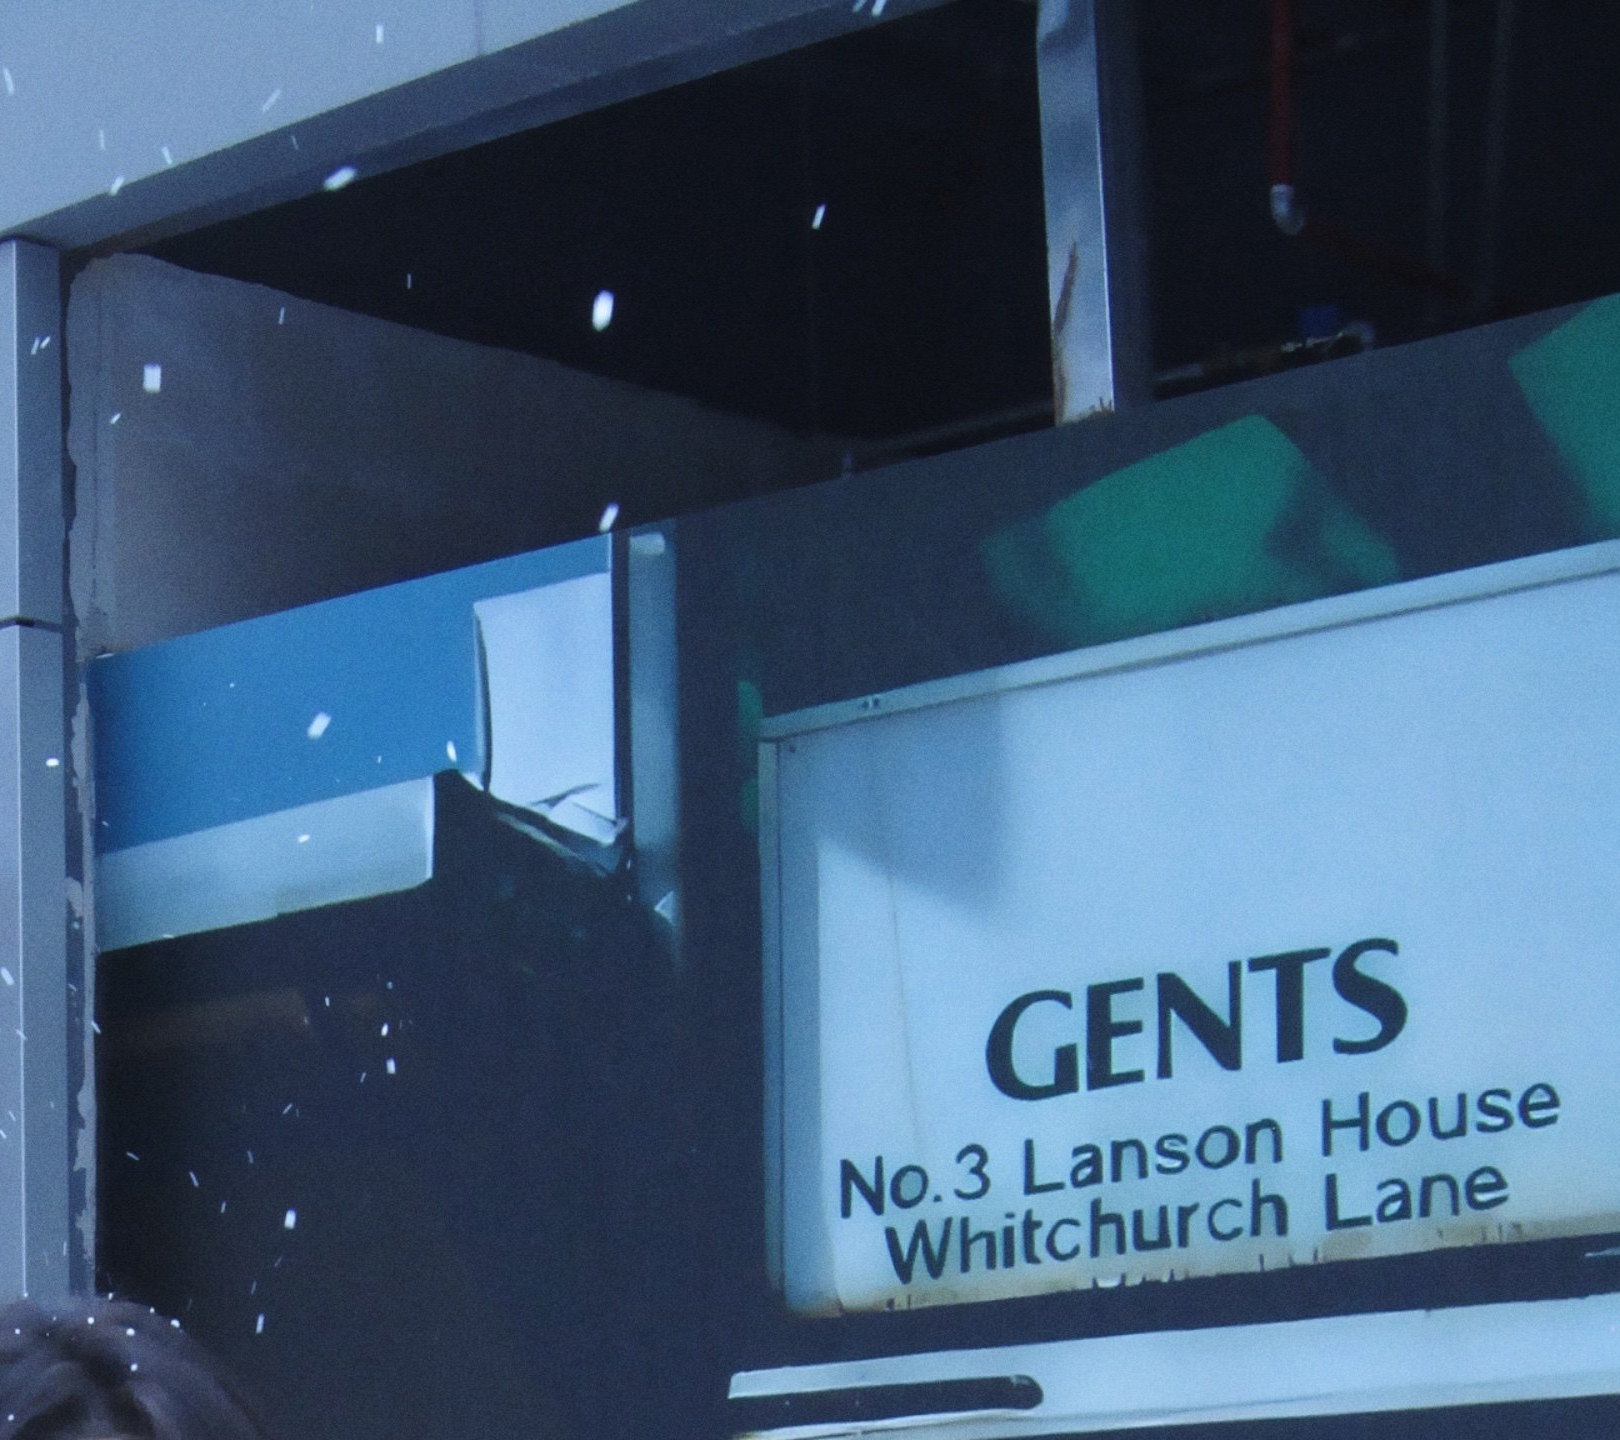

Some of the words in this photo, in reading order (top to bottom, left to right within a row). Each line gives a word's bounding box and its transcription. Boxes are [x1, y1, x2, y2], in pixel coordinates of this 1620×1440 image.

[984, 937, 1409, 1102] GENTS
[1022, 1115, 1285, 1197] Lanson
[1320, 1080, 1561, 1158] House
[884, 1179, 1290, 1285] Whitchurch
[1323, 1164, 1510, 1232] Lane
